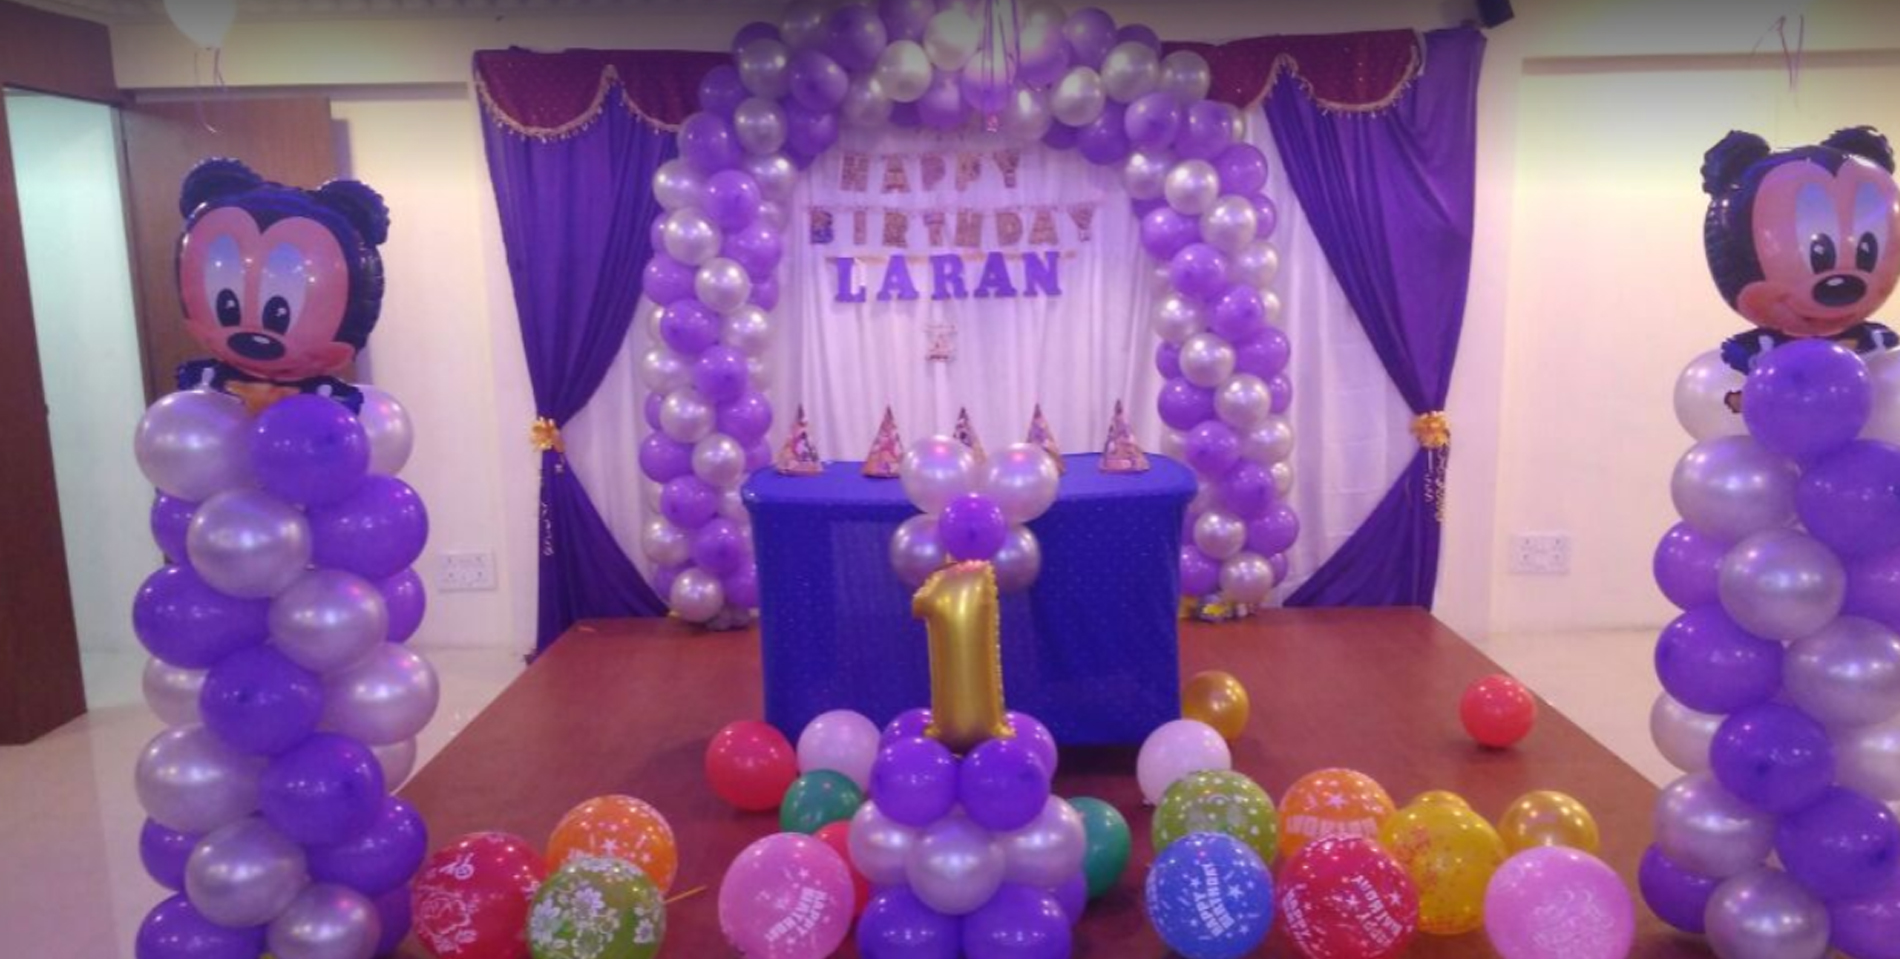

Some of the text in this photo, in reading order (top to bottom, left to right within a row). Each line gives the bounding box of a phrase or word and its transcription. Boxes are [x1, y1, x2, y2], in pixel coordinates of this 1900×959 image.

[839, 152, 1020, 193] HAPPY
[809, 203, 1094, 248] BIRTHDAY
[834, 251, 1062, 303] LARAN
[912, 560, 1017, 752] 1
[1193, 892, 1226, 937] HAPPY
[1201, 863, 1235, 929] BIRTHDAY
